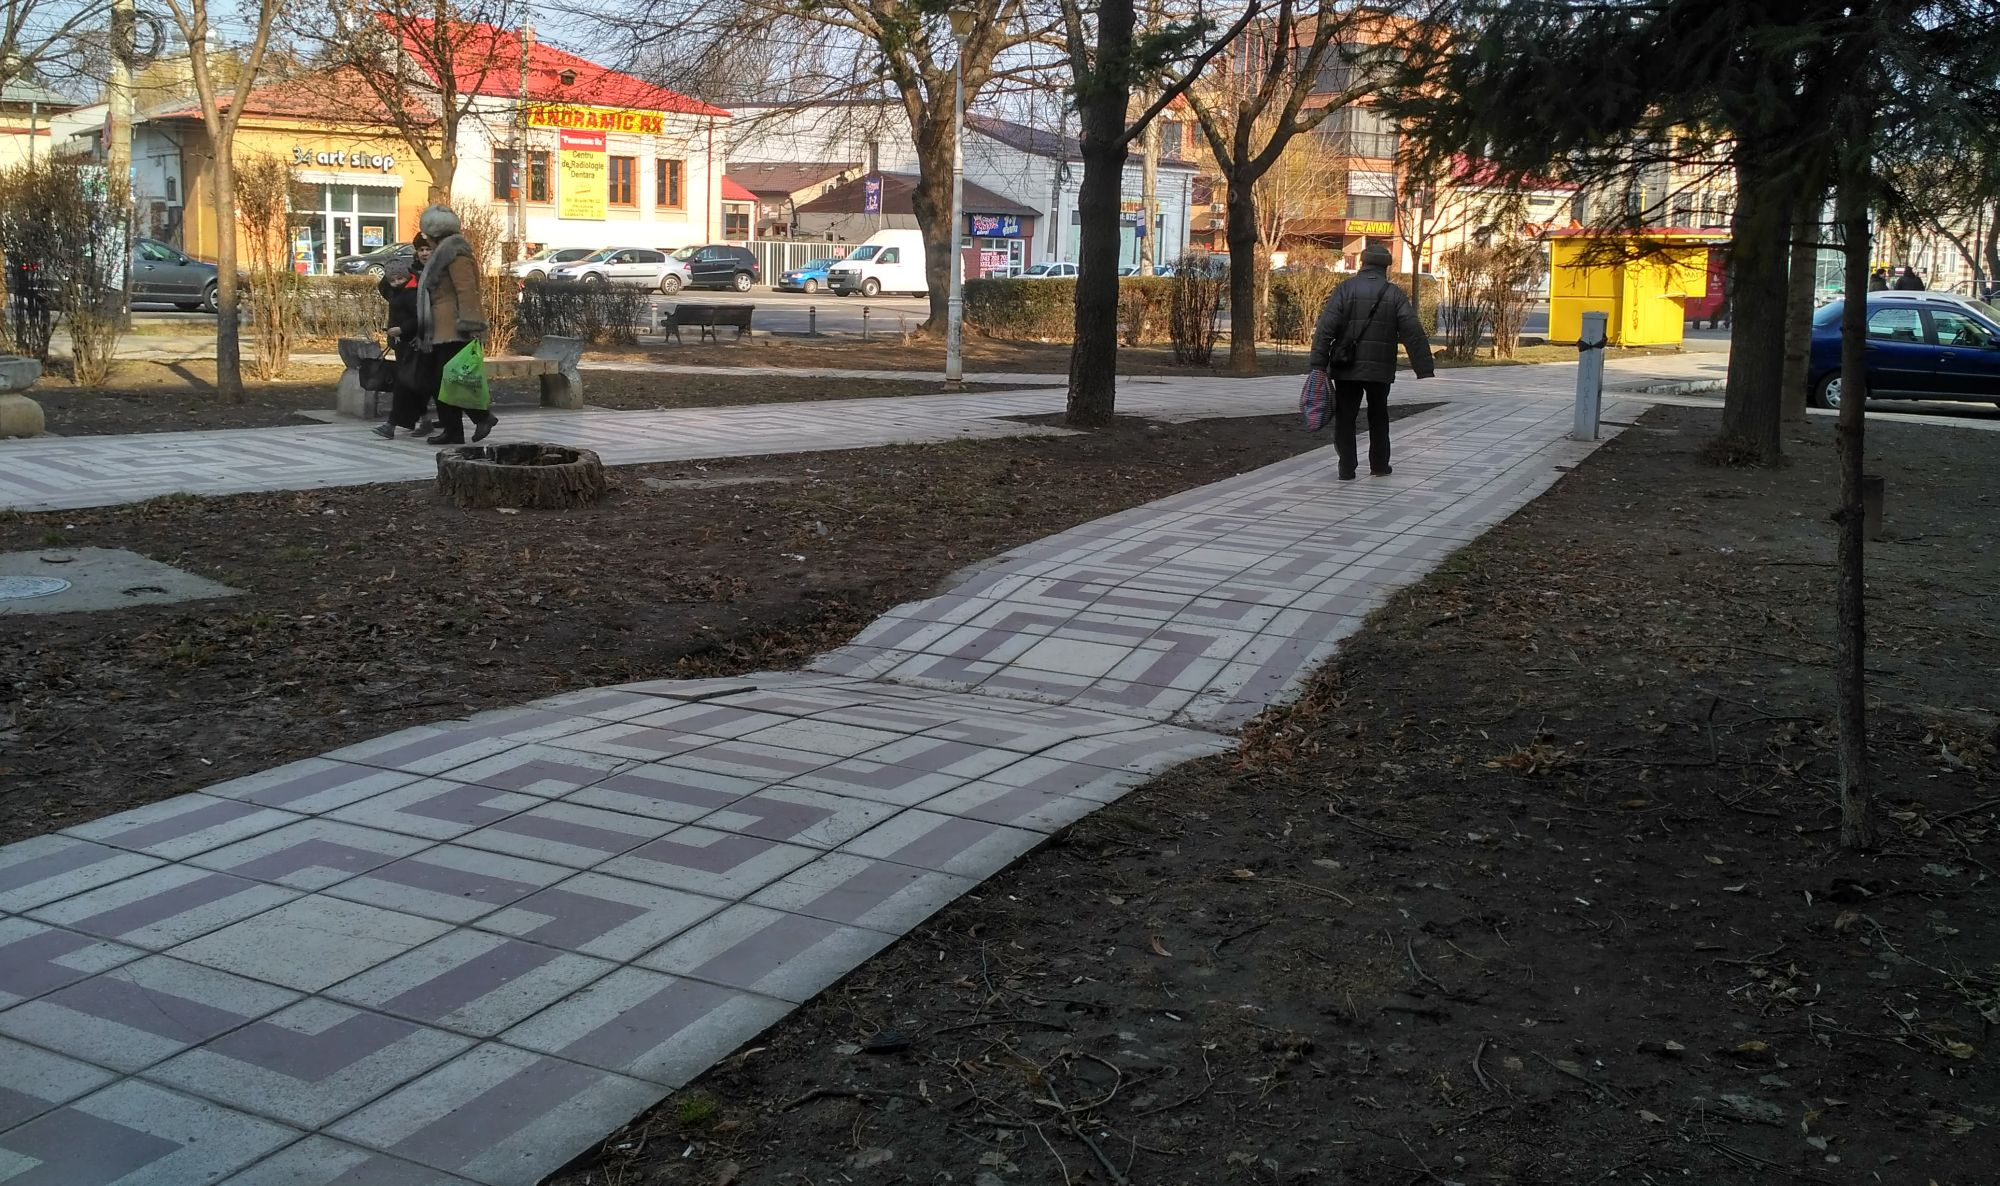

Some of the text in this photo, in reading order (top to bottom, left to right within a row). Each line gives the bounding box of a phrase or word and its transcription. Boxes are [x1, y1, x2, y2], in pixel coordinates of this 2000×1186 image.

[640, 115, 662, 133] RX
[572, 150, 594, 159] Centru
[316, 150, 345, 166] art
[350, 151, 395, 174] shop
[571, 160, 604, 171] Radiologie
